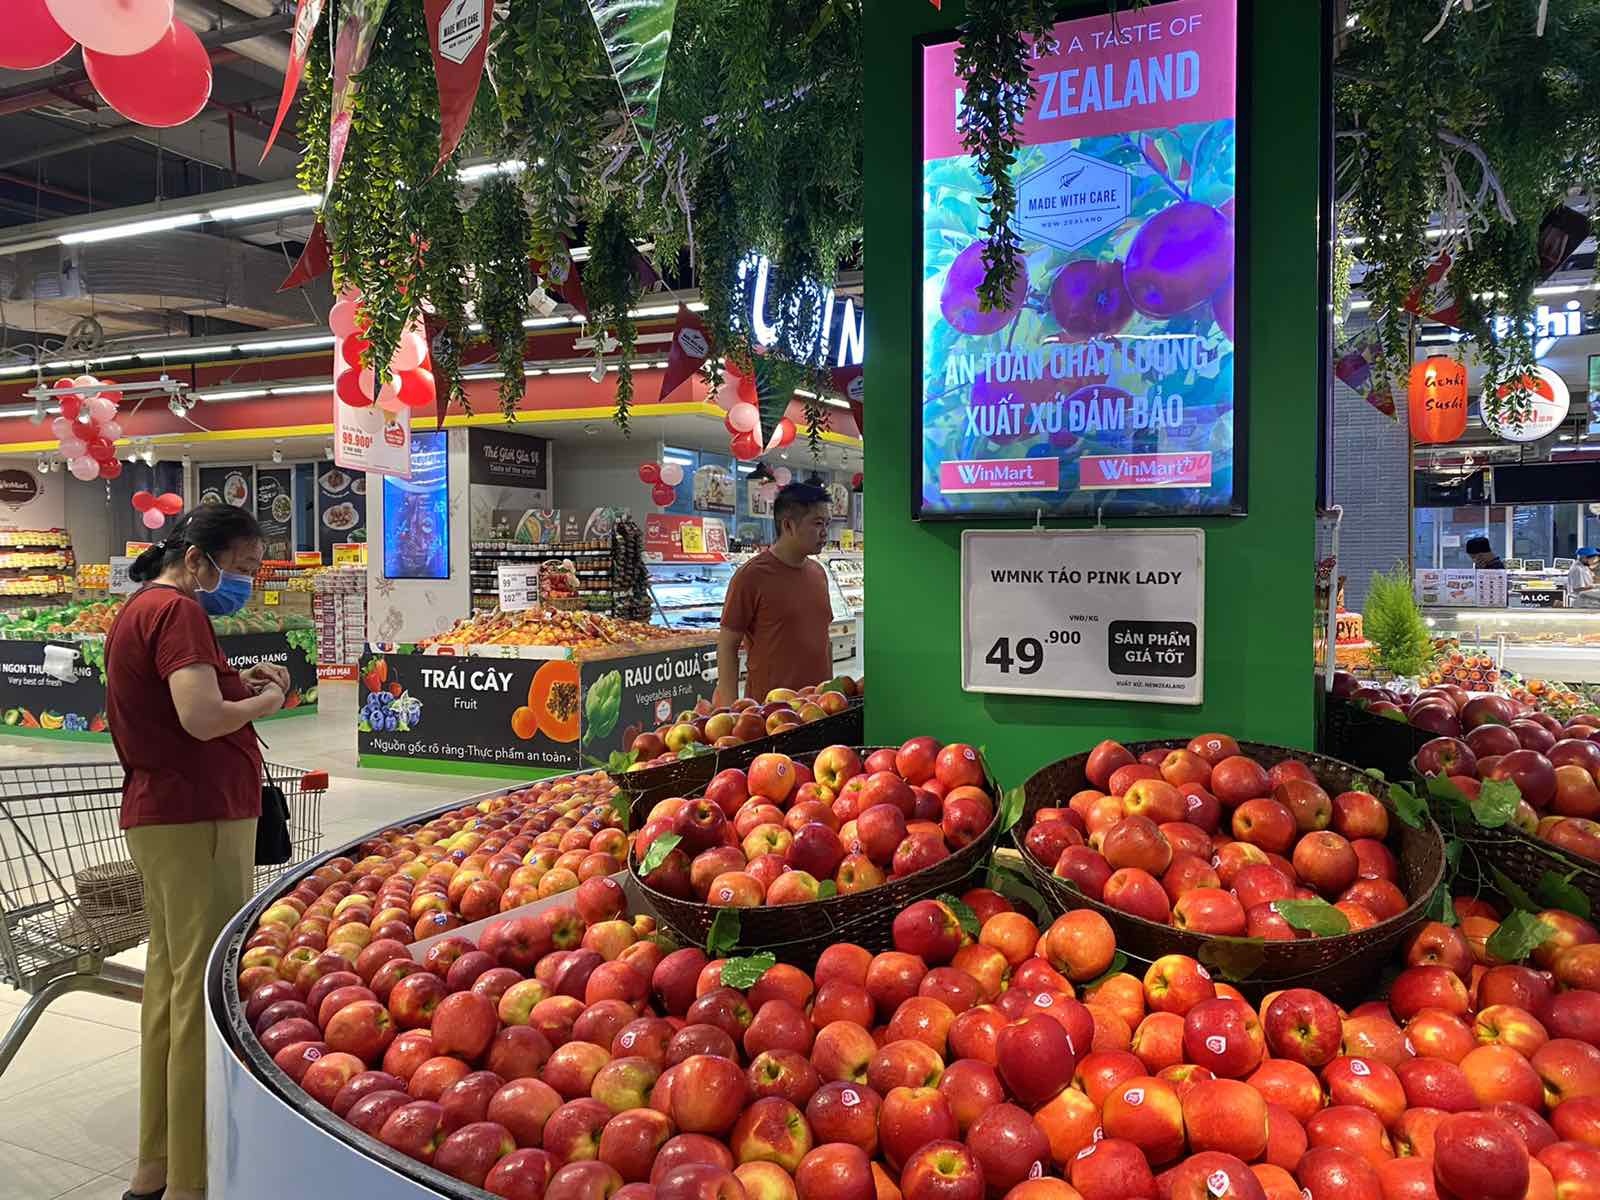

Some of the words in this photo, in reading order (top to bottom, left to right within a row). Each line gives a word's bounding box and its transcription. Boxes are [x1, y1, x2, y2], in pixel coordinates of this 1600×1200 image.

[1067, 35, 1083, 55] A
[1090, 22, 1162, 50] TASTE
[1168, 14, 1203, 36] OF
[1038, 49, 1201, 121] ZEALAND
[1028, 197, 1057, 212] MADE
[1060, 192, 1086, 208] WITH
[1089, 189, 1117, 204] CARE
[1063, 214, 1103, 228] ZEALAND
[944, 353, 975, 386] AN
[964, 393, 1025, 437] XUẤT
[1029, 391, 1066, 434] XỨ
[1068, 388, 1125, 433] ĐẢM
[1132, 385, 1184, 430] BẢO
[1425, 396, 1463, 411] Sushi
[957, 463, 1034, 485] WinMart
[991, 570, 1044, 584] WMNK
[1048, 566, 1082, 585] TÁO
[1087, 571, 1131, 585] PINK
[1135, 571, 1182, 585] LADY
[1114, 630, 1144, 645] SẢN
[1148, 631, 1190, 647] PHẨM
[985, 637, 1044, 675] 49
[1125, 648, 1153, 663] GIÁ
[1155, 648, 1185, 665] TỐT
[2, 663, 27, 674] NGON
[624, 665, 652, 688] RAU
[655, 657, 673, 682] CỦ
[675, 652, 702, 678] QUẢ
[7, 676, 23, 684] Very
[23, 677, 37, 686] best
[38, 678, 45, 686] of
[421, 665, 465, 690] TRÁI
[470, 667, 514, 692] CÂY
[672, 686, 678, 697] &
[454, 697, 478, 710] Fruit
[408, 743, 427, 755] gốc
[429, 744, 440, 754] rõ
[495, 747, 525, 762] phẩm
[527, 752, 541, 761] an
